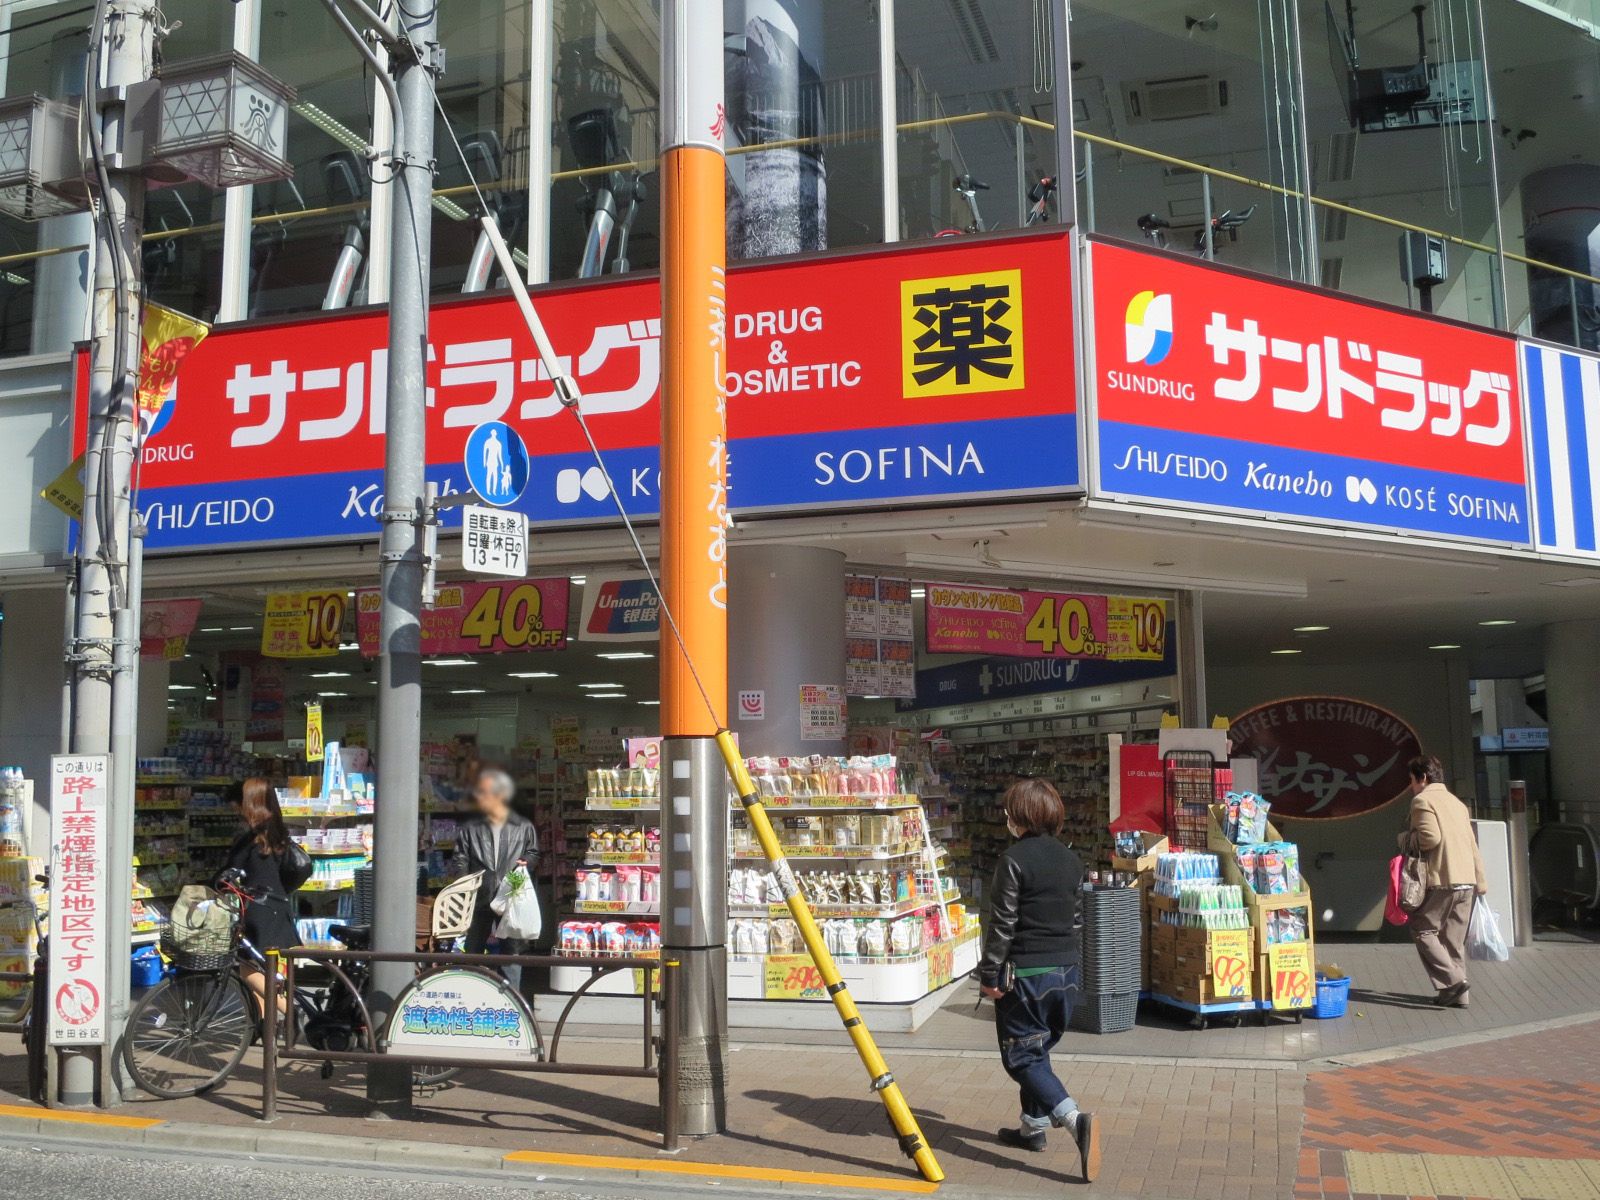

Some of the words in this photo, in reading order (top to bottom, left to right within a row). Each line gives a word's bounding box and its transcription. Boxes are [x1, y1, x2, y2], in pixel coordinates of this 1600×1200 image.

[734, 306, 823, 339] DRUG
[912, 283, 1014, 386] 薬
[767, 340, 788, 364] &
[726, 361, 862, 397] OSMETIC
[1107, 370, 1195, 401] SUNDRUG
[1205, 311, 1510, 447] サンドラッグ
[141, 497, 275, 531] SHISEIDO
[815, 441, 985, 485] SOFINA
[1113, 445, 1228, 482] SHISEIDO
[1243, 461, 1333, 498] Kanebo
[1386, 485, 1437, 513] KOSÉ
[1448, 493, 1520, 525] SOFINA
[469, 513, 524, 535] 自転車を除く
[526, 629, 563, 647] OFF
[934, 627, 980, 640] Kanebo
[996, 659, 1062, 688] SUNDRUG
[1285, 706, 1298, 723] &
[1304, 702, 1413, 747] RESTAURANT
[56, 761, 103, 774] この通りは
[60, 775, 97, 972] 路上禁煙指定地区です
[1214, 955, 1246, 988] 98
[1275, 970, 1309, 1001] 118
[55, 1028, 100, 1039] 世田谷区
[402, 1004, 521, 1038] 遮熱性舗装
[508, 1039, 520, 1047] です
